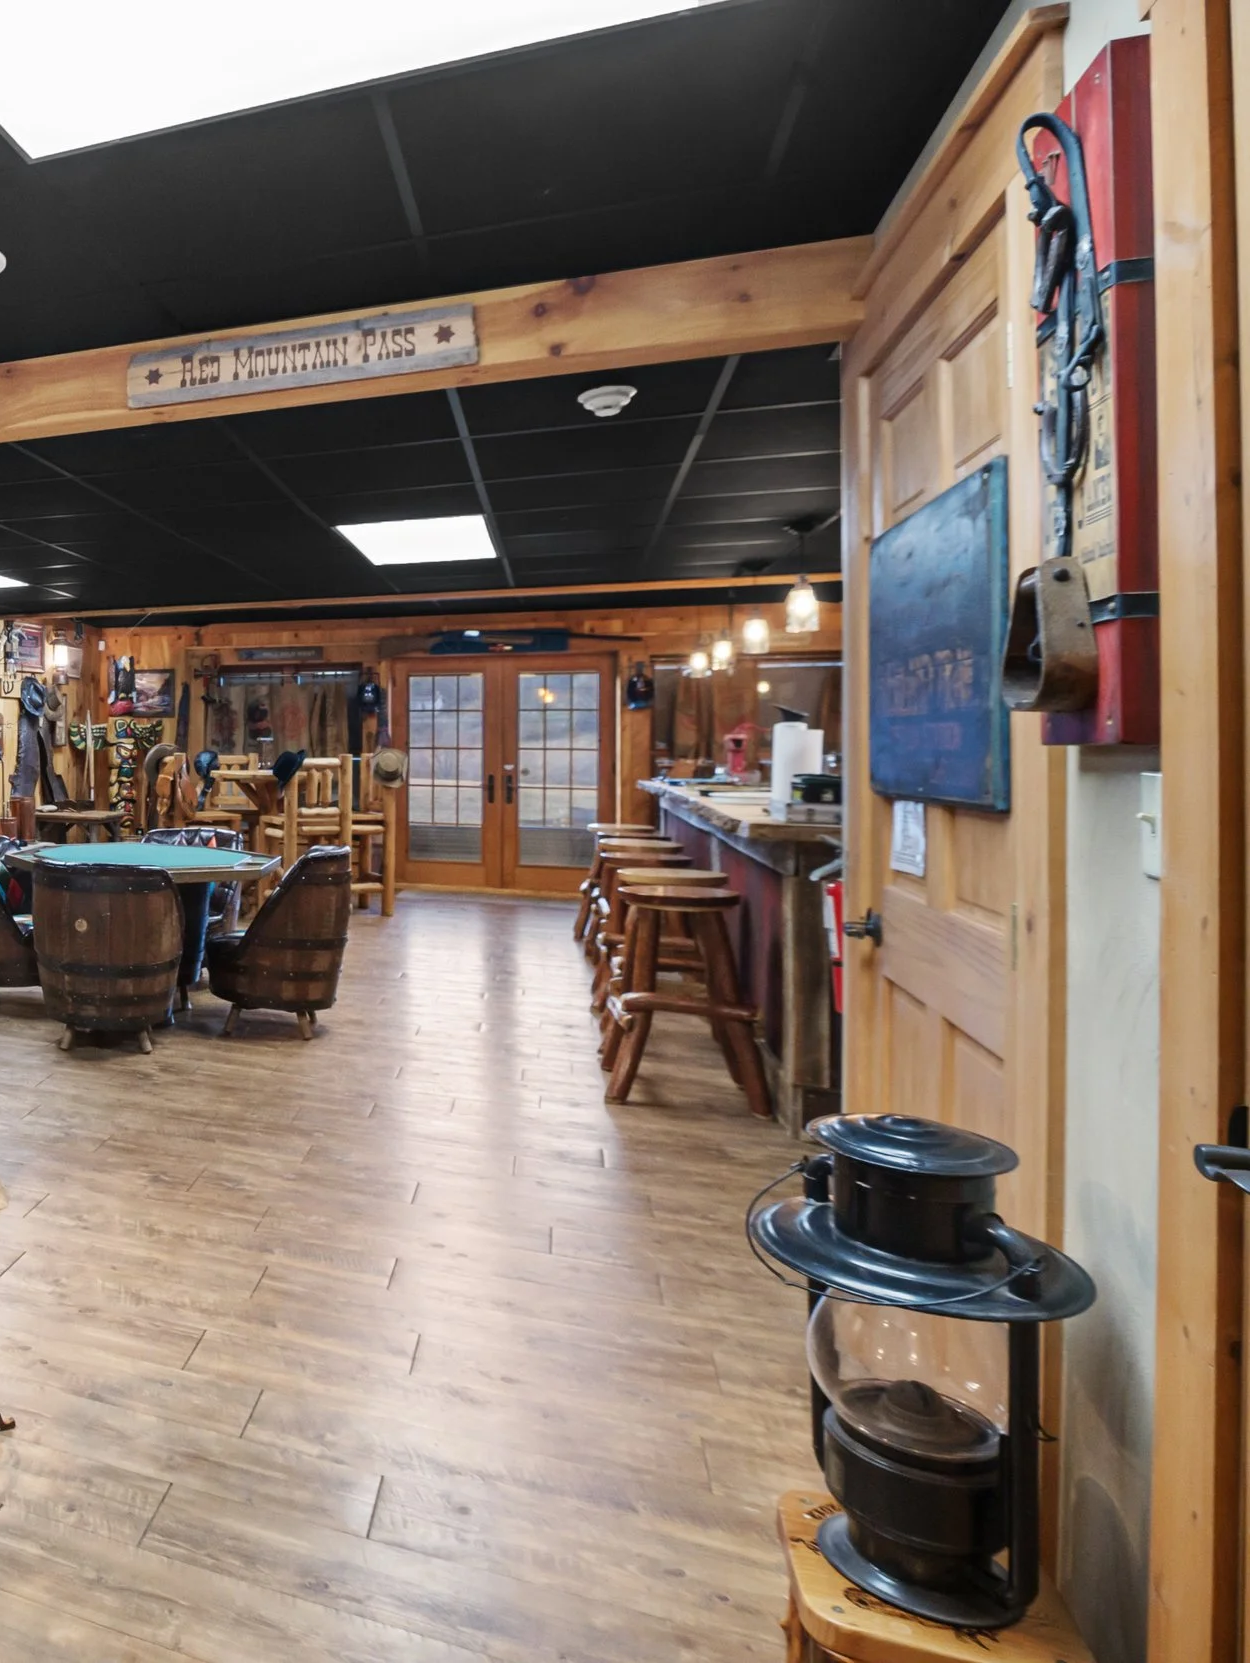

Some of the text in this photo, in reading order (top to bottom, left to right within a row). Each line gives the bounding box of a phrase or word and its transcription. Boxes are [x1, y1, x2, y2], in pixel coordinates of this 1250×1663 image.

[180, 326, 416, 388] RED MOUNTAIN PASS
